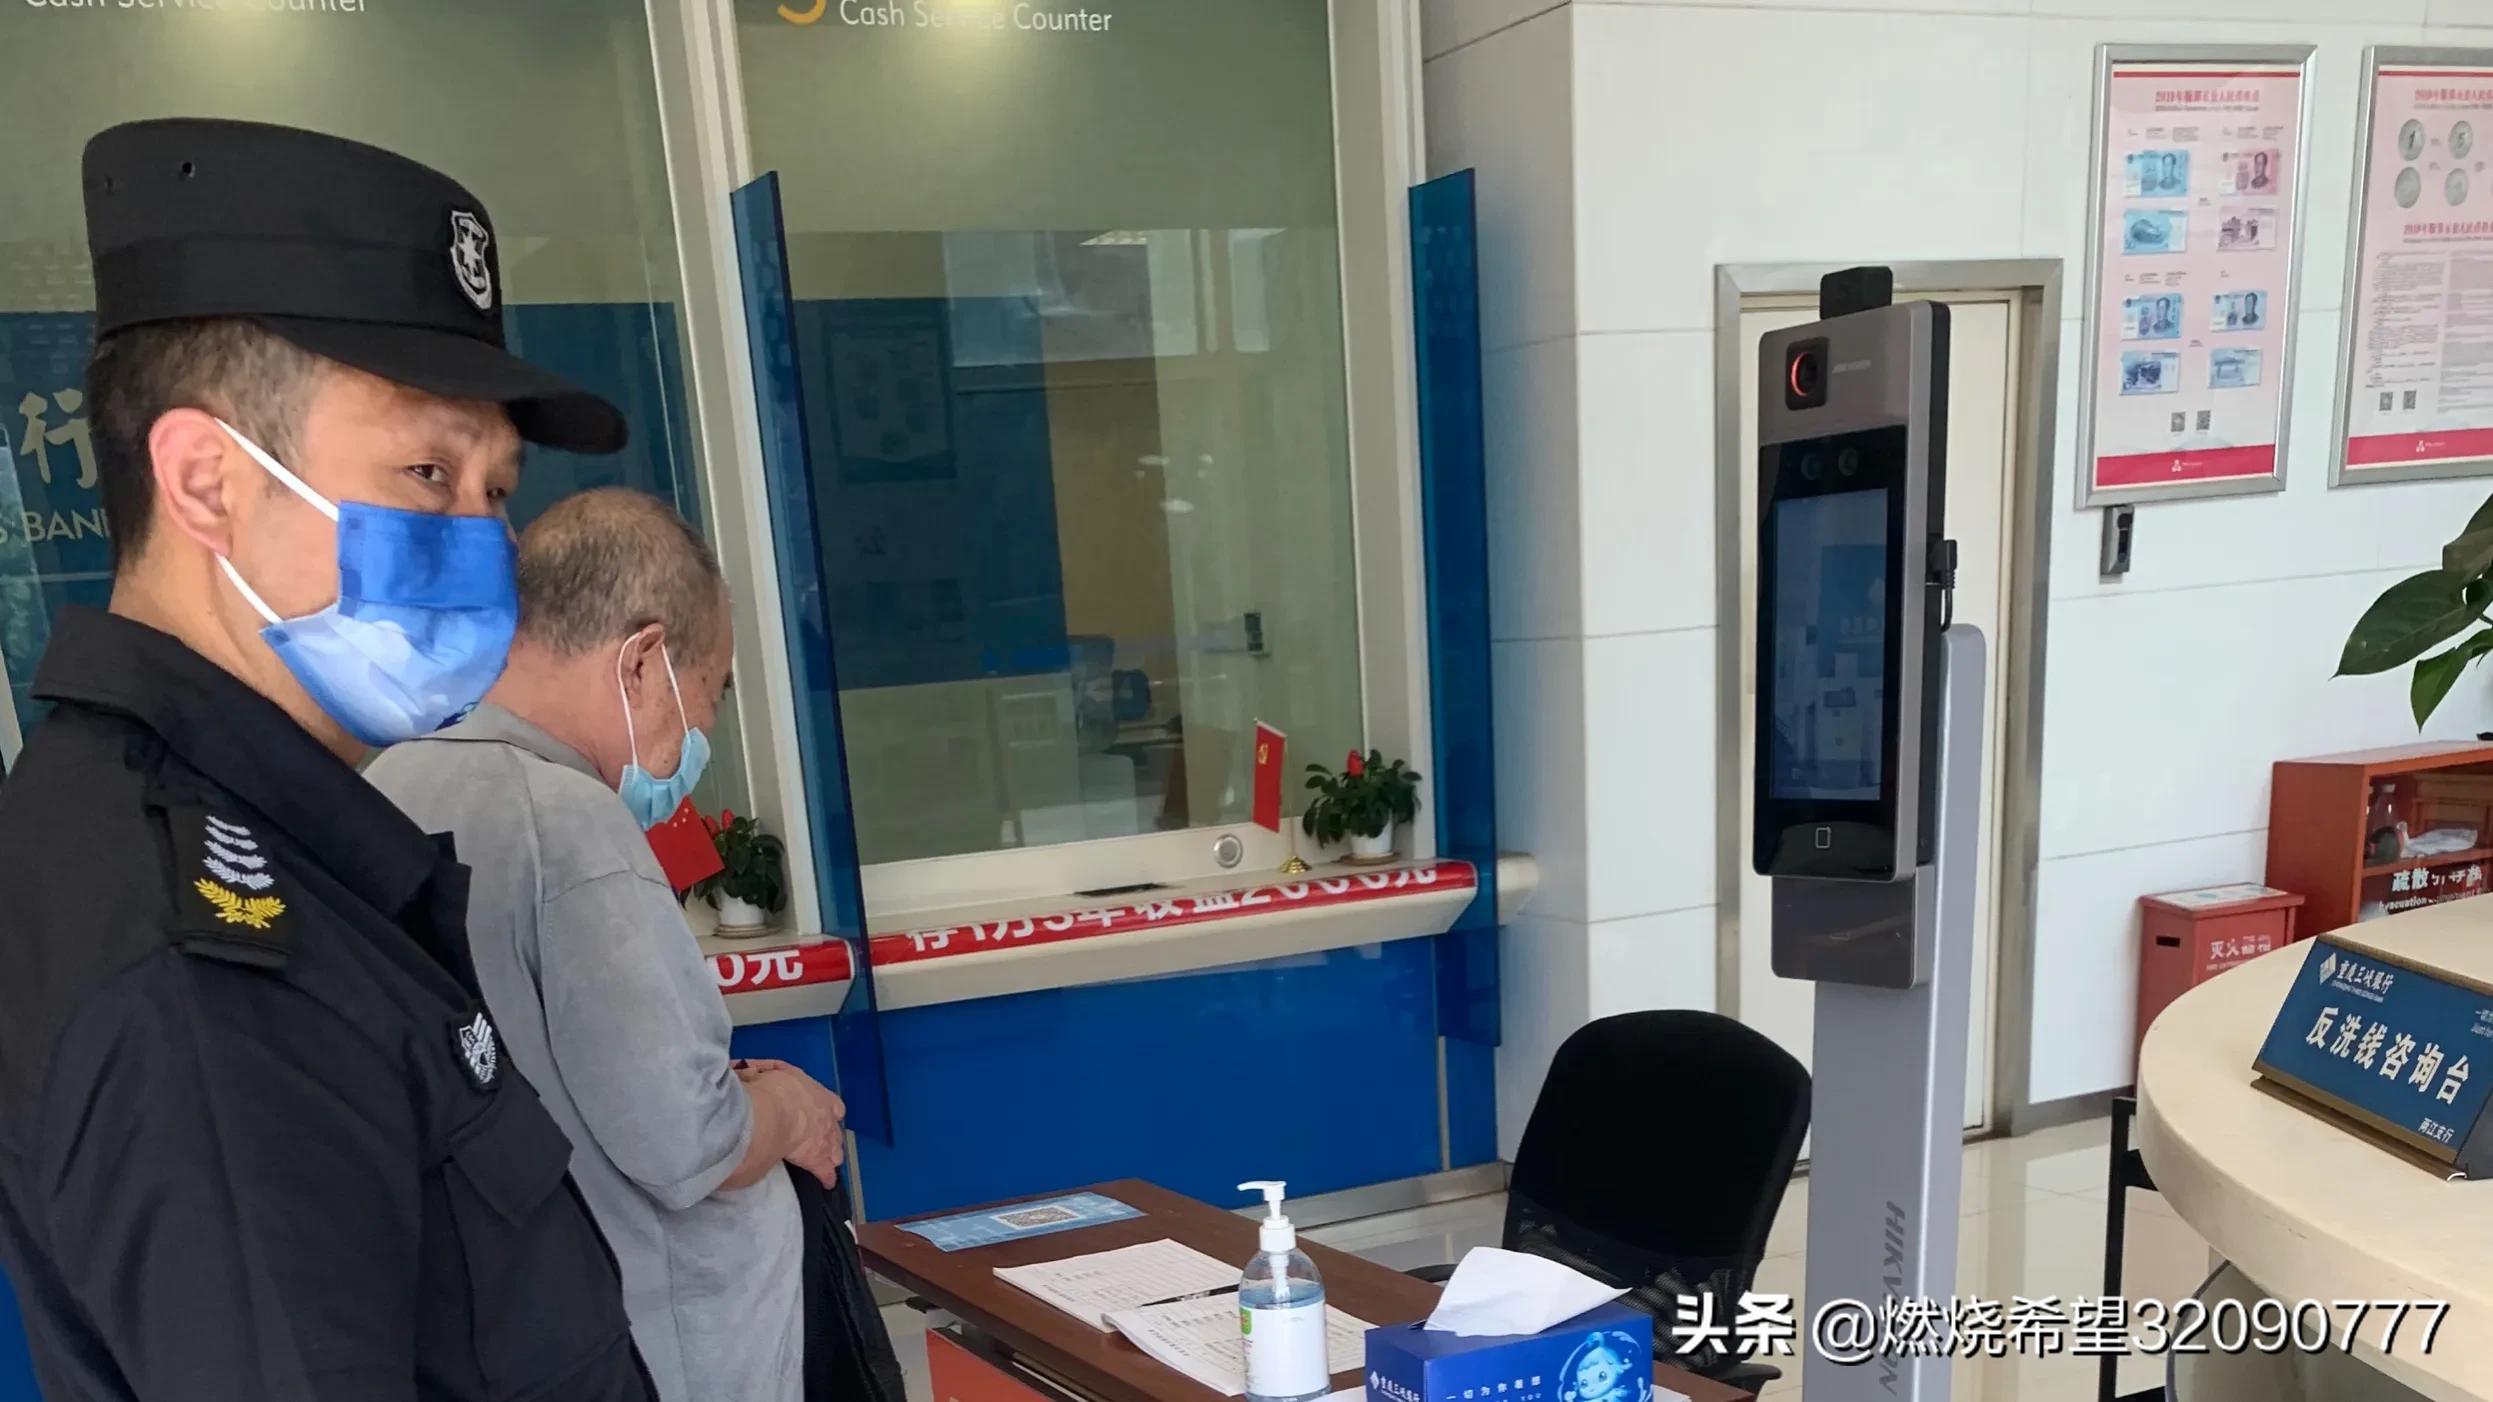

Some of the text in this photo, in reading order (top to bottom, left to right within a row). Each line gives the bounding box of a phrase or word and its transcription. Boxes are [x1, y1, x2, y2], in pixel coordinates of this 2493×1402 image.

[839, 0, 905, 26] Cash
[1013, 3, 1112, 31] Counter
[24, 508, 111, 543] BAN
[2305, 1006, 2470, 1105] 反洗钱咨询台
[2418, 1117, 2456, 1144] 两江支行
[1879, 1200, 1906, 1396] HIKVON
